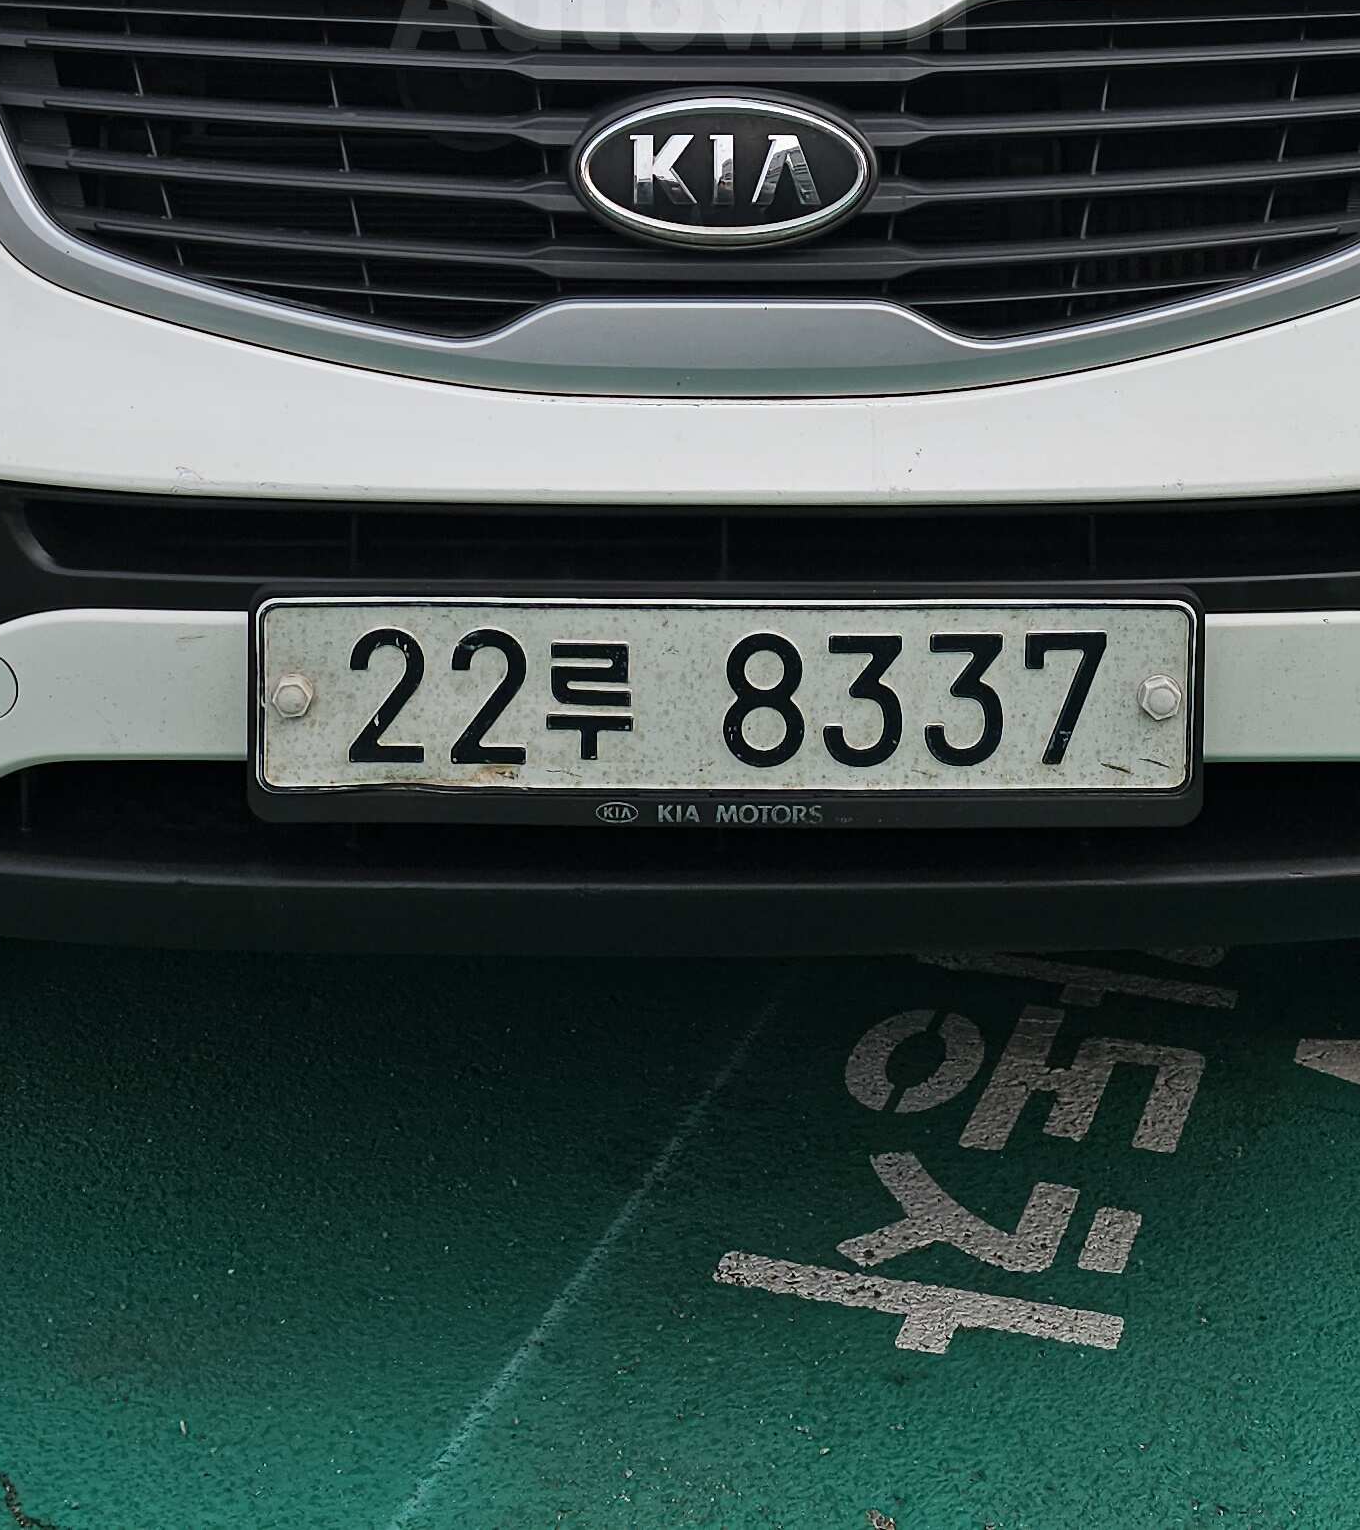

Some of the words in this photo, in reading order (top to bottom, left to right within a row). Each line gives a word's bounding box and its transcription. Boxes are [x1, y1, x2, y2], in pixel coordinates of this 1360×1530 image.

[628, 134, 822, 205] KIA
[347, 628, 634, 765] 22루
[722, 629, 1108, 768] 8337
[657, 804, 701, 823] KIA
[715, 804, 824, 824] MOTORS
